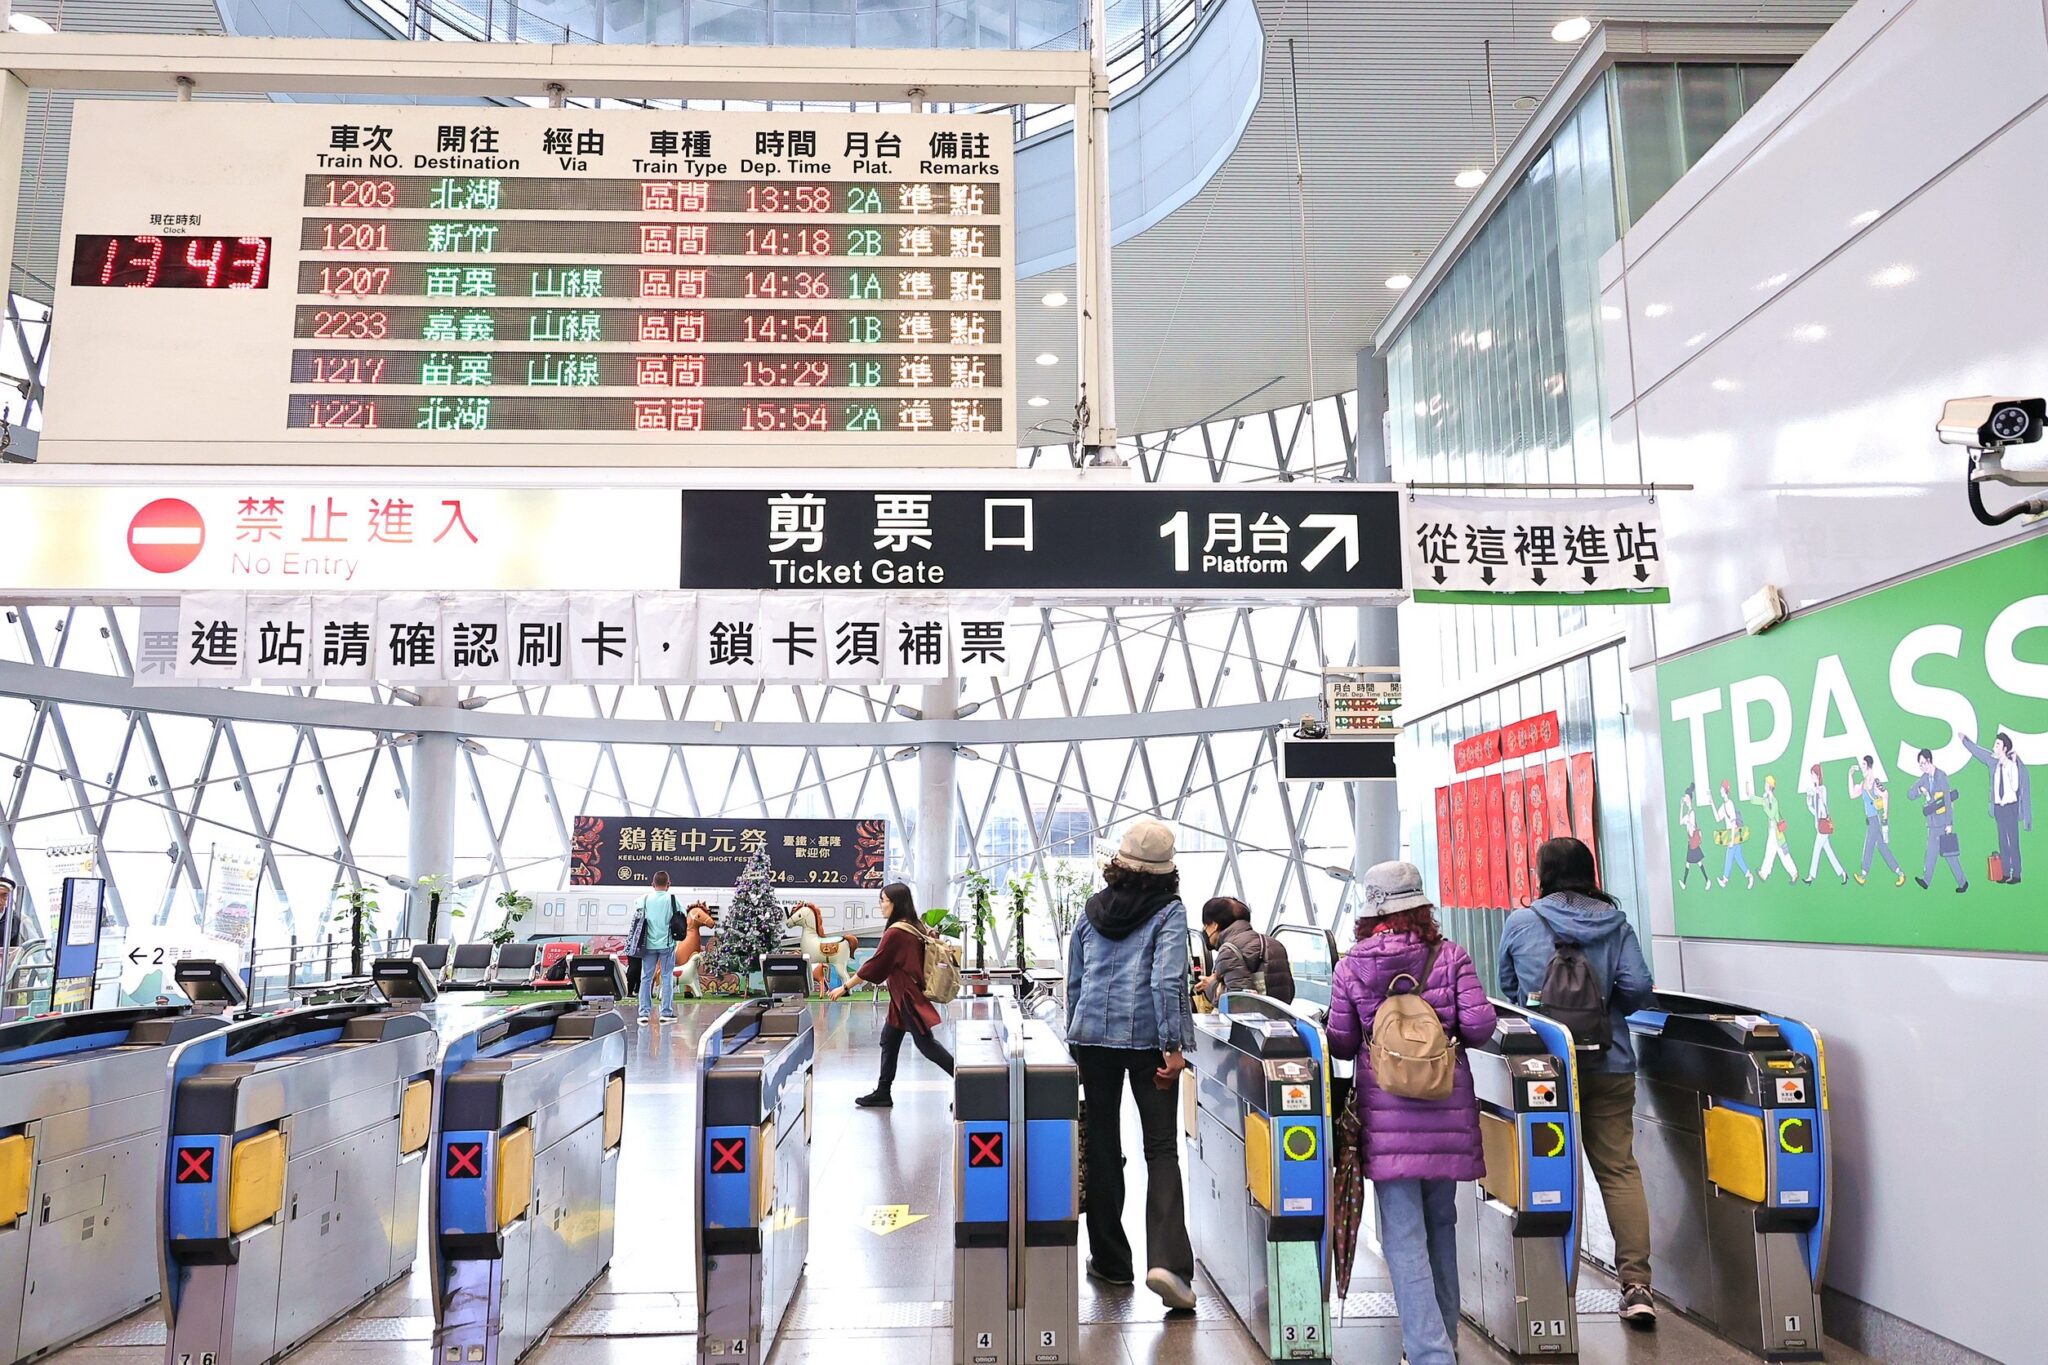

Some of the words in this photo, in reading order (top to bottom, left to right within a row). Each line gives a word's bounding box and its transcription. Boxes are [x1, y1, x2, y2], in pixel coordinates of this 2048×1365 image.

[330, 125, 393, 152] 車次
[437, 126, 500, 153] 開往
[543, 127, 604, 156] 經由
[649, 129, 712, 158] 車種
[755, 130, 816, 158] 時間
[844, 131, 902, 159] 月台
[929, 131, 990, 159] 備註
[316, 153, 363, 168] Train
[369, 154, 403, 169] NO.
[414, 154, 520, 171] Destination
[559, 157, 588, 172] Via
[632, 158, 678, 174] Train
[684, 158, 728, 178] Type
[740, 159, 781, 178] Dep.
[787, 159, 831, 174] Time
[853, 160, 893, 174] Plat.
[920, 160, 999, 175] Remarks
[325, 180, 394, 207] 1203
[430, 179, 500, 210] 北湖
[641, 182, 709, 213] 區間
[746, 187, 830, 213] 13:58
[848, 188, 882, 213] 2A
[150, 214, 201, 226] 現在時刻
[163, 226, 186, 234] Clock
[322, 224, 389, 250] 1201
[428, 223, 498, 252] 新竹
[640, 226, 708, 255] 區間
[746, 229, 830, 256] 14:18
[848, 230, 882, 256] 2B
[319, 267, 390, 294] 1207
[427, 268, 496, 297] 苗栗
[532, 268, 602, 298] 山線
[639, 269, 707, 298] 區間
[745, 272, 829, 298] 14:36
[849, 273, 882, 299] 1A
[313, 311, 387, 338] 2233
[423, 309, 494, 341] 嘉義
[530, 311, 600, 341] 山線
[638, 310, 704, 342] 區間
[744, 315, 828, 342] 14:54
[849, 316, 882, 343] 1B
[312, 357, 384, 383] 1217
[422, 353, 492, 386] 苗栗
[528, 354, 598, 386] 山線
[636, 355, 704, 387] 區間
[742, 361, 828, 387] 15:29
[849, 361, 882, 387] 1B
[309, 401, 377, 429] 1221
[417, 398, 490, 430] 北湖
[634, 399, 704, 430] 區間
[742, 403, 828, 430] 15:54
[846, 404, 882, 431] 2A
[236, 497, 478, 543] 禁止進入
[768, 493, 1034, 552] 剪票口
[1160, 512, 1189, 572] 1
[1203, 512, 1290, 555] 月台
[1416, 522, 1660, 566] 從這裡進站
[232, 552, 272, 574] No
[284, 552, 359, 580] Entry
[769, 559, 863, 584] Ticket
[872, 559, 945, 584] Gate
[1203, 555, 1288, 574] Platform
[1334, 683, 1350, 692] 月台
[1357, 683, 1375, 692] 時間
[795, 847, 831, 859] 歡迎你
[153, 947, 164, 965] 2
[1286, 1326, 1295, 1341] 3
[1306, 1326, 1316, 1340] 2
[1533, 1321, 1543, 1335] 2
[1554, 1321, 1561, 1335] 1
[1789, 1317, 1796, 1330] 1
[734, 1340, 744, 1354] 4
[979, 1334, 989, 1348] 4
[1043, 1332, 1052, 1346] 3
